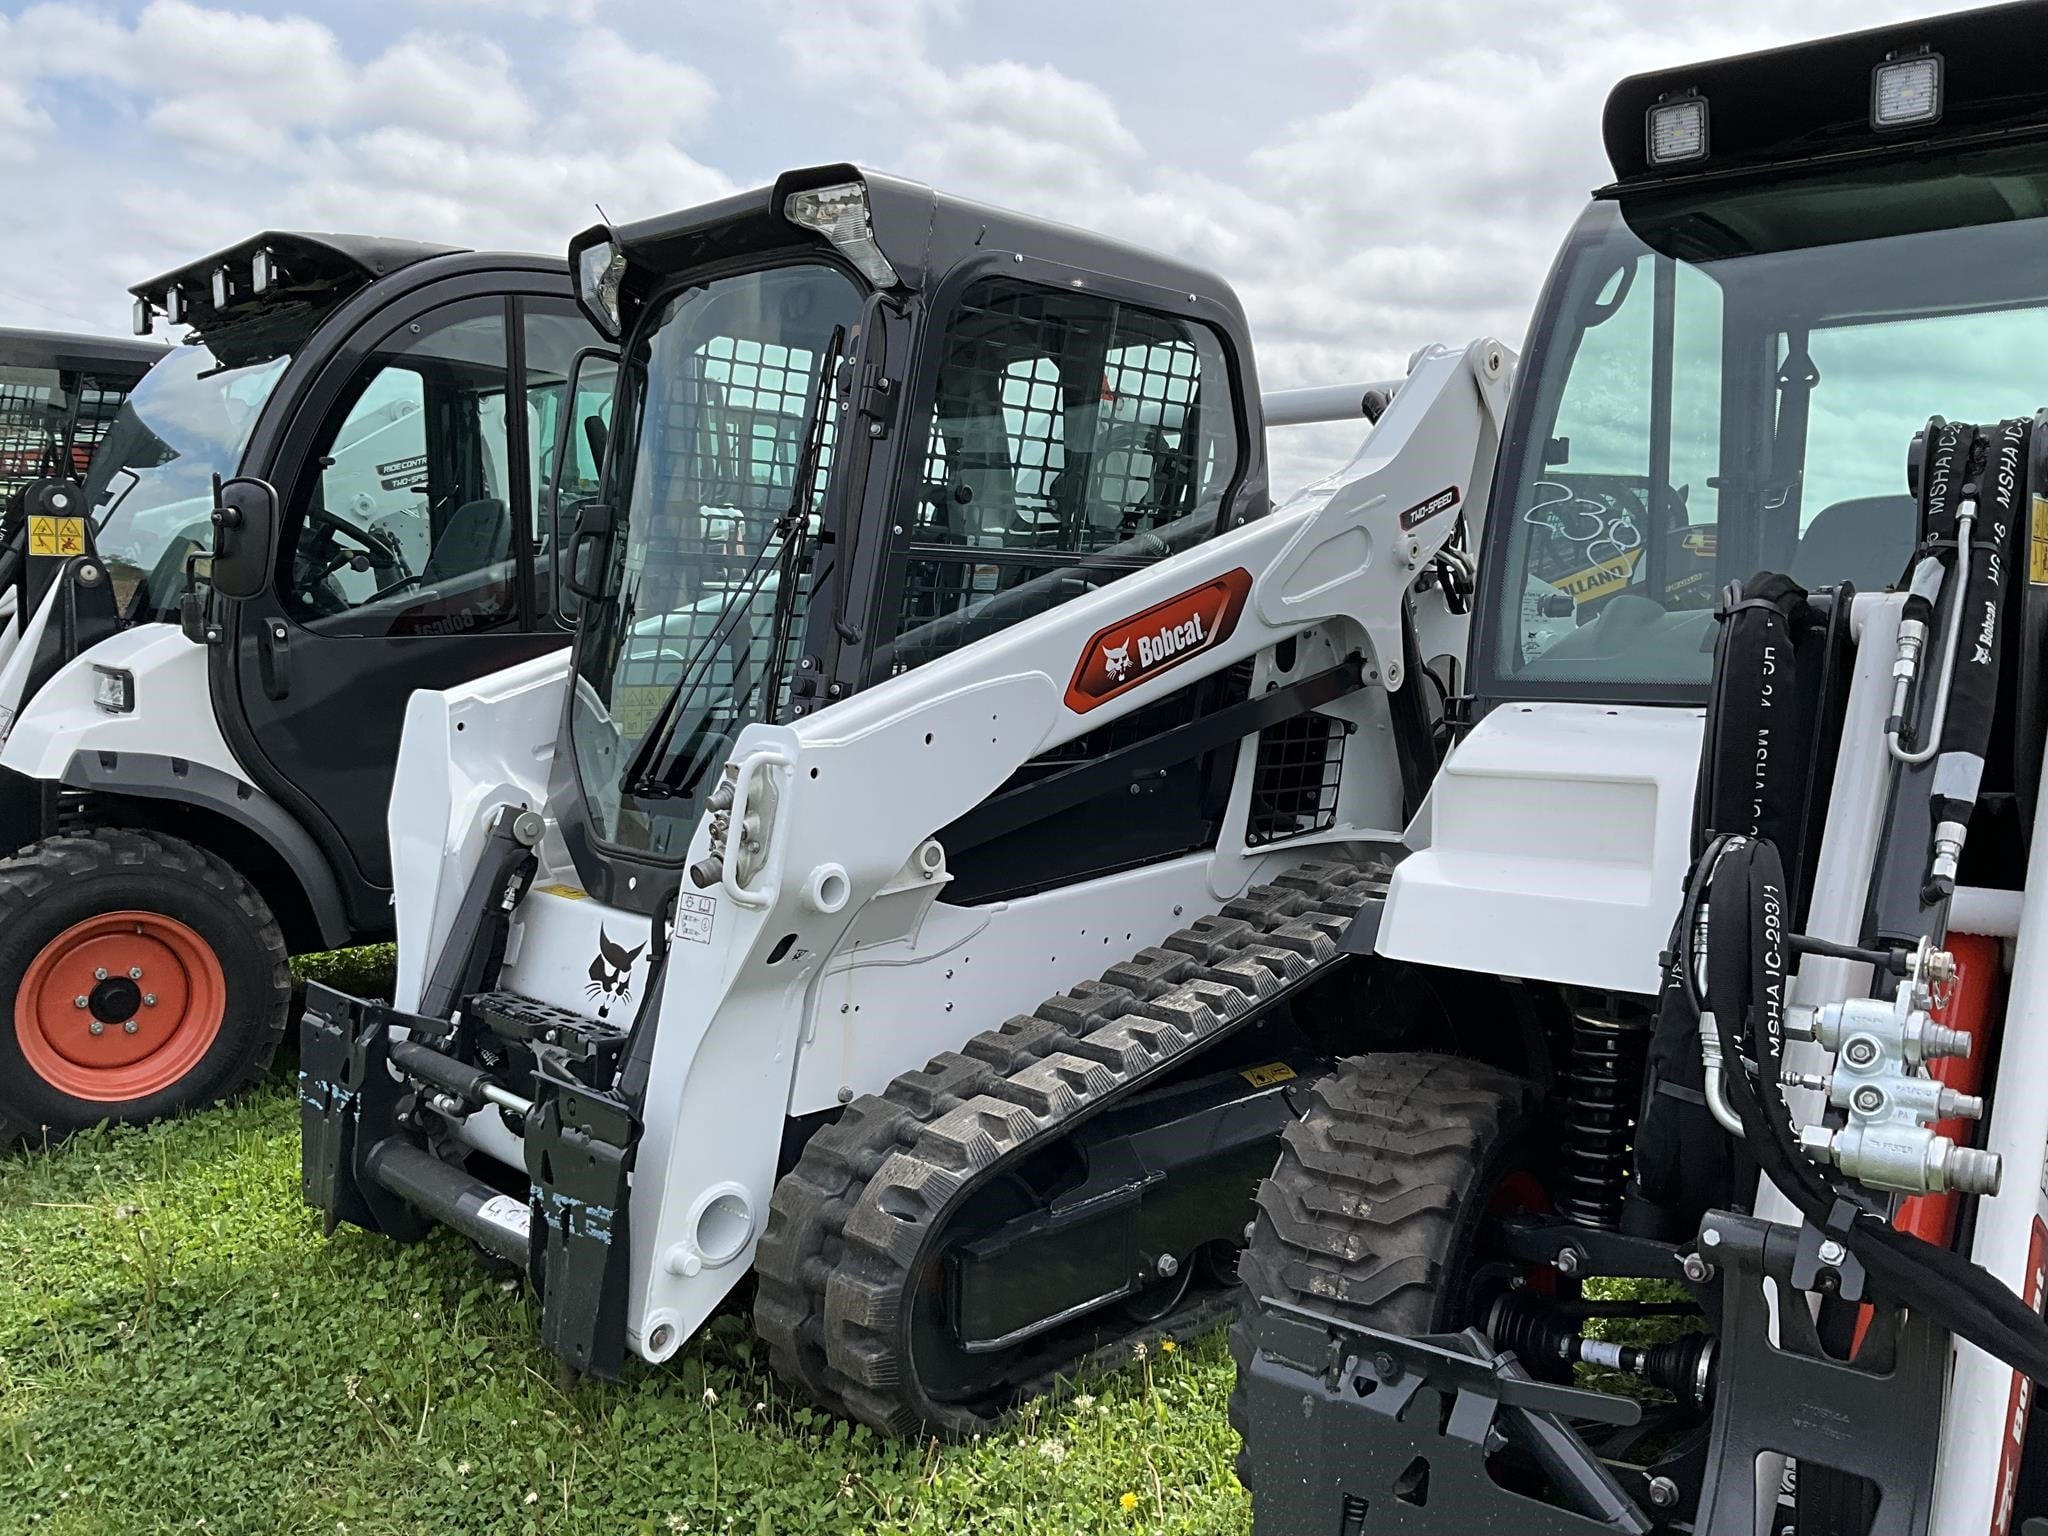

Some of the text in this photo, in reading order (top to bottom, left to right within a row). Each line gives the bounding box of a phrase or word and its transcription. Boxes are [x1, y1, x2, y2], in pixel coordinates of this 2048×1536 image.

[401, 456, 428, 469] CONTR
[1929, 456, 1953, 515] MSHA
[1996, 446, 2019, 509] MSHA
[1410, 491, 1453, 523] TWO-SPEED
[1137, 612, 1205, 669] Bobcat
[1980, 600, 1997, 648] Bobcat
[1763, 885, 1782, 1058] MSHA IC-293/1
